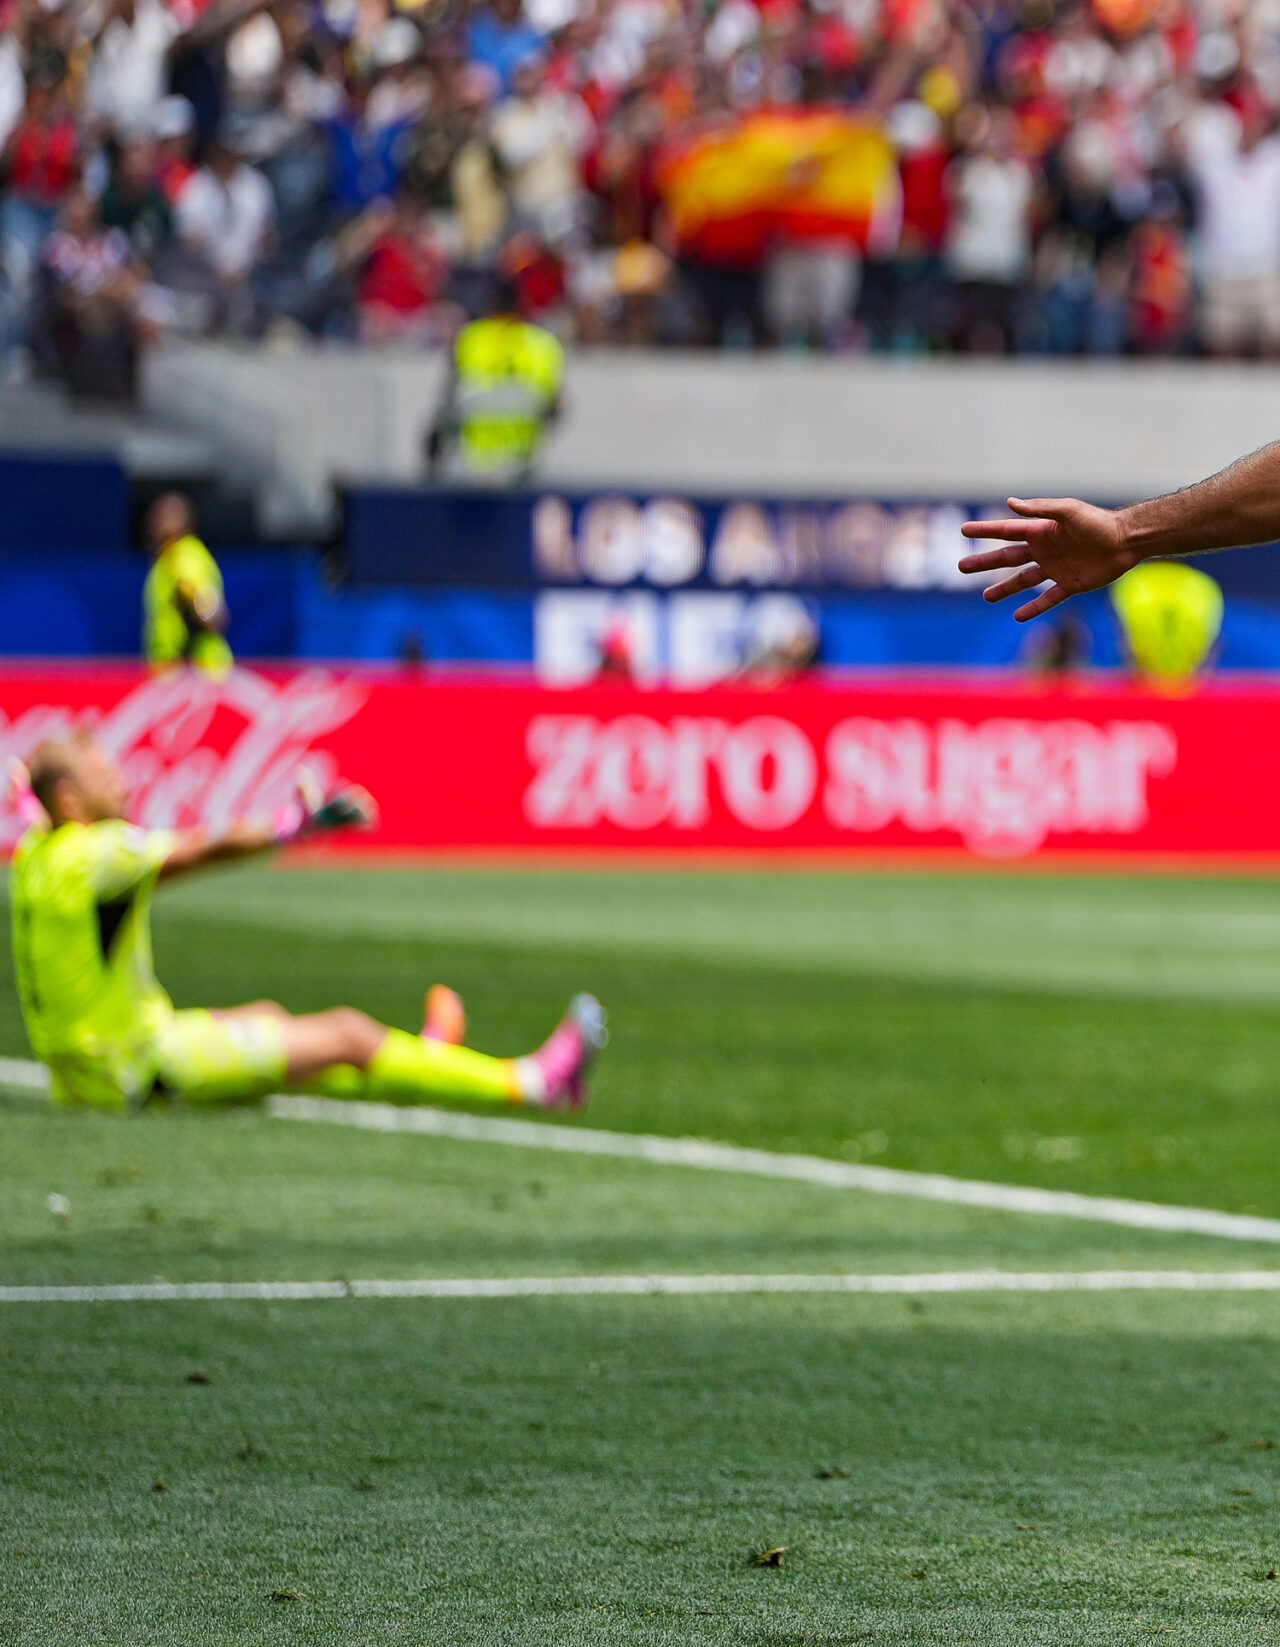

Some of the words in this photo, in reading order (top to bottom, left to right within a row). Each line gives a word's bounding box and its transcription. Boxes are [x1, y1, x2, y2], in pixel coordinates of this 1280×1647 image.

[531, 498, 703, 591] LOS
[525, 713, 818, 831] zero
[822, 715, 1179, 860] sugar
